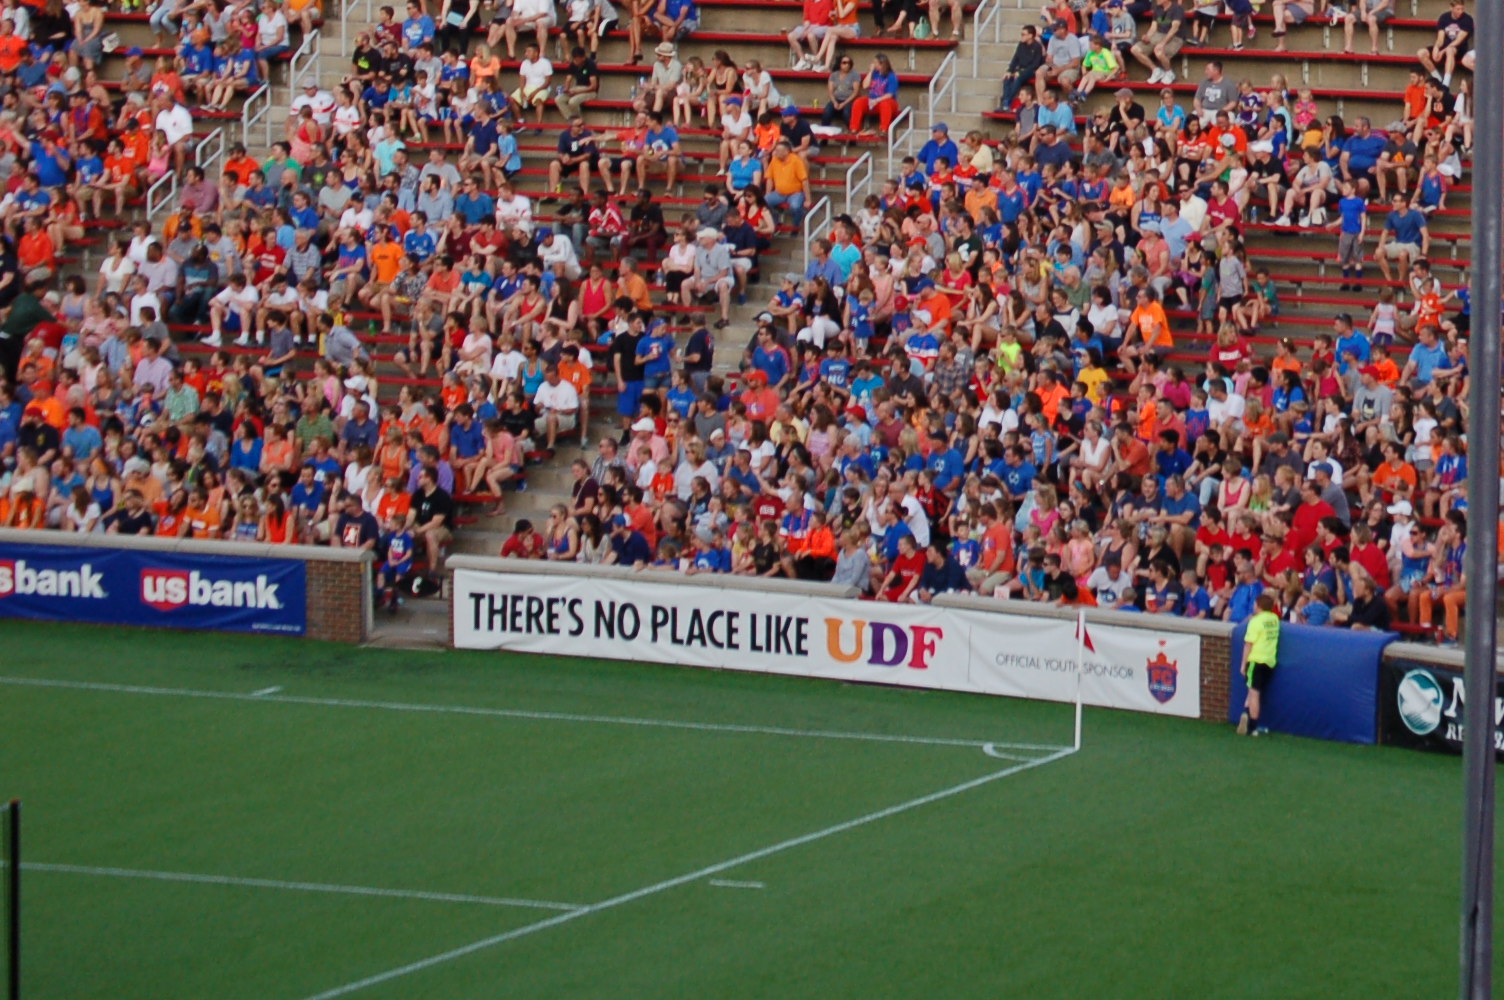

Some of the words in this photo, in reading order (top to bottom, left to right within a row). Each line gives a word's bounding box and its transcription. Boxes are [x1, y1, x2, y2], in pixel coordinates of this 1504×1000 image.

[469, 592, 584, 636] THERE'S
[594, 600, 641, 642] NO
[651, 605, 740, 650] PLACE
[750, 613, 810, 656] LIKE
[824, 617, 943, 669] UDF
[996, 653, 1041, 670] OFFICIAL
[1082, 662, 1134, 679] SPONSOR
